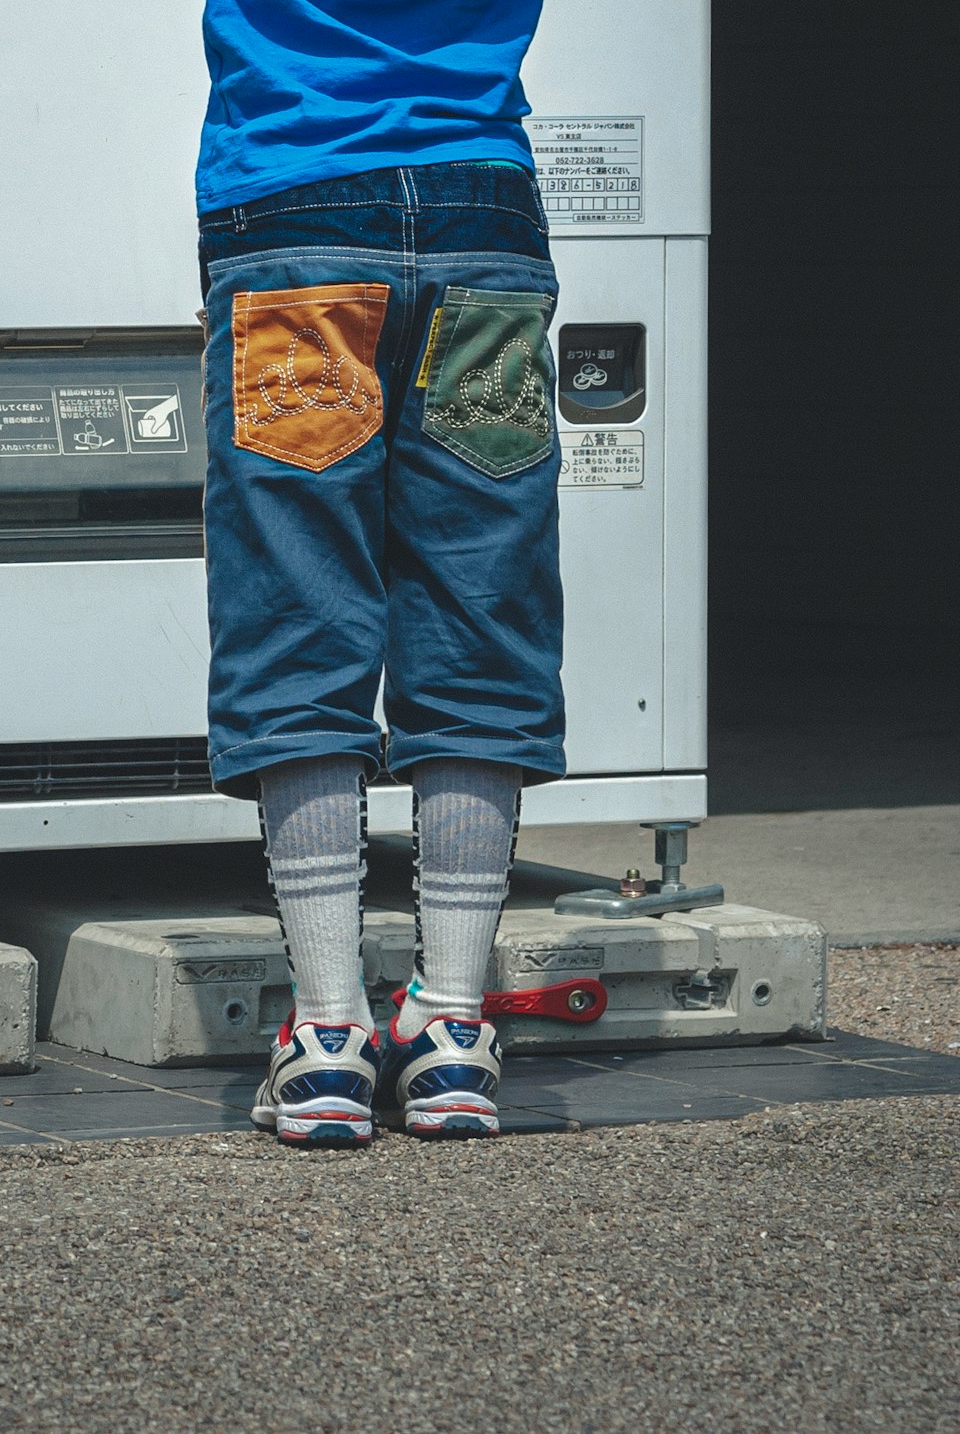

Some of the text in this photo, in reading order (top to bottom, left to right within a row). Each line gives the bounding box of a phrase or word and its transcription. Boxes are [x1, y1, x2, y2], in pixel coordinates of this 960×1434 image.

[566, 349, 616, 360] おつり・返却
[594, 433, 618, 446] 警告
